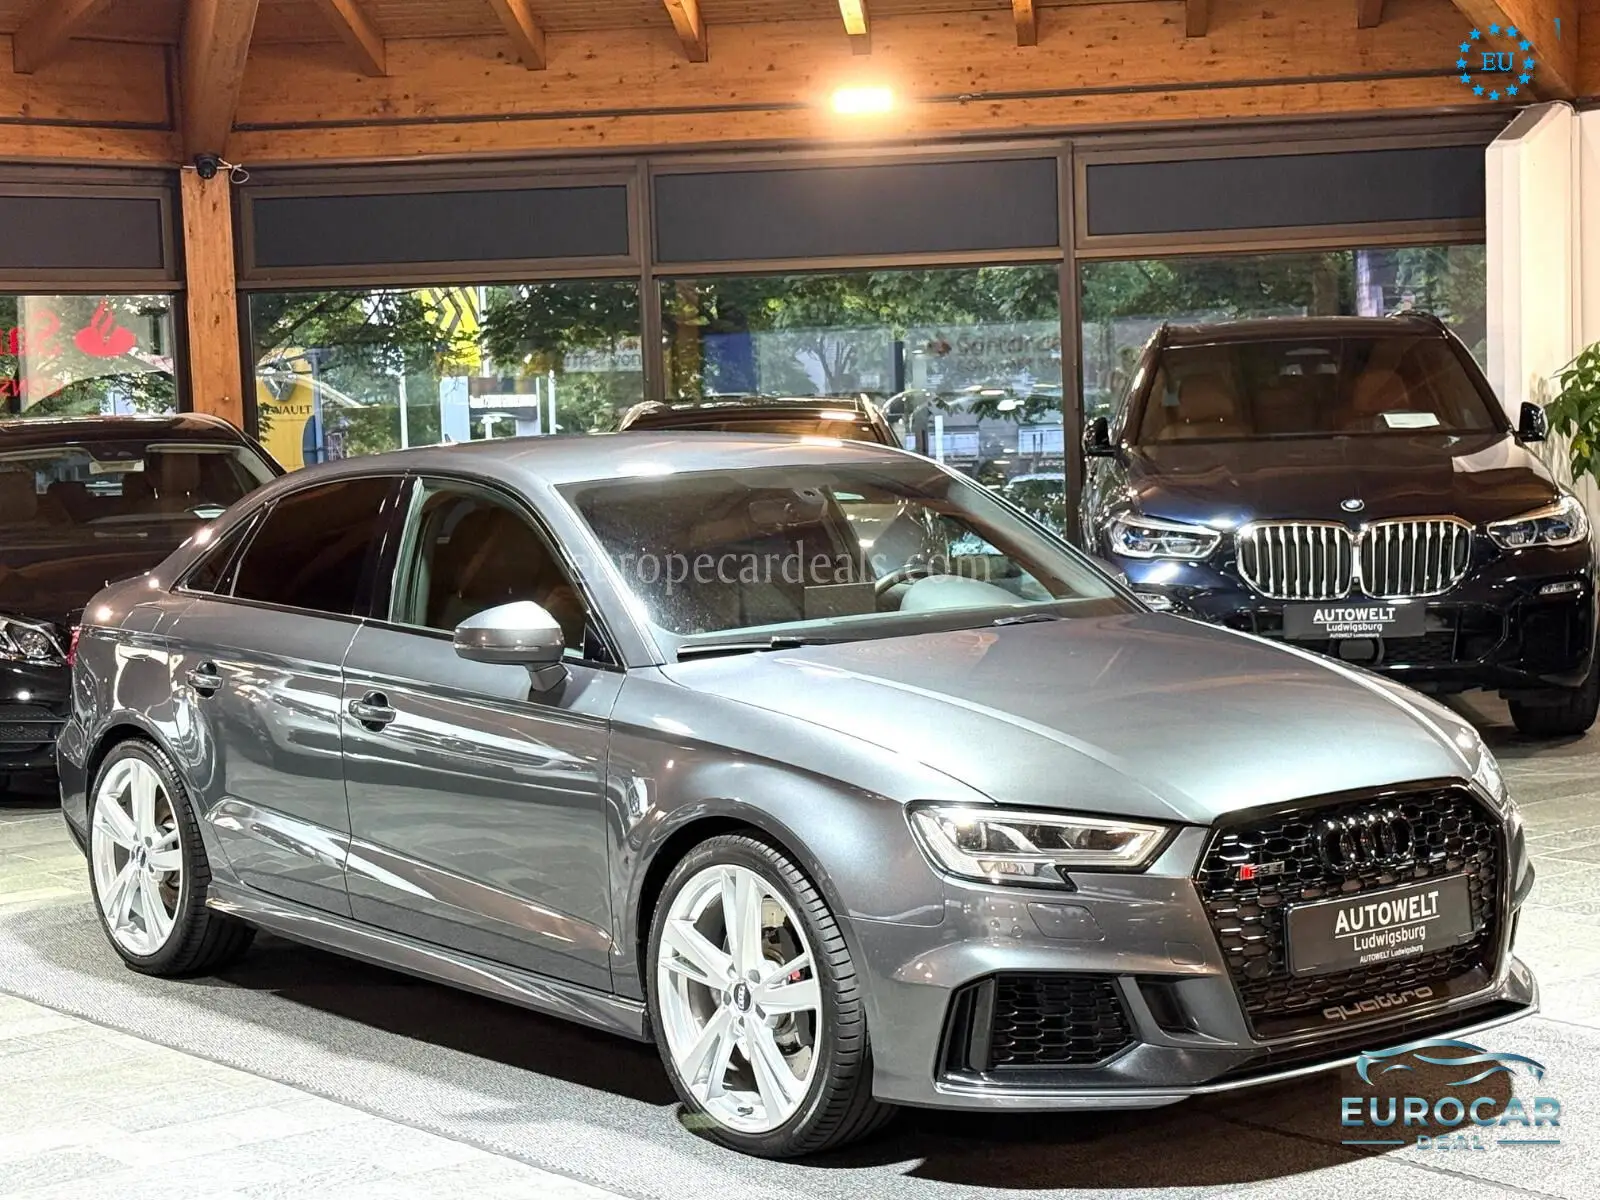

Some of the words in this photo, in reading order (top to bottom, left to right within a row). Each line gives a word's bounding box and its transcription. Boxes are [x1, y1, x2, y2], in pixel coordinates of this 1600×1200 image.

[1314, 607, 1396, 621] AUTOWELT
[1326, 623, 1382, 632] Ludwigsburg
[1334, 890, 1439, 934] AUTOWELT
[1353, 925, 1426, 951] Ludwigsburg
[1359, 950, 1390, 964] AUTOWELT
[1390, 944, 1424, 957] Ludwigsburg
[1322, 985, 1434, 1020] quattro
